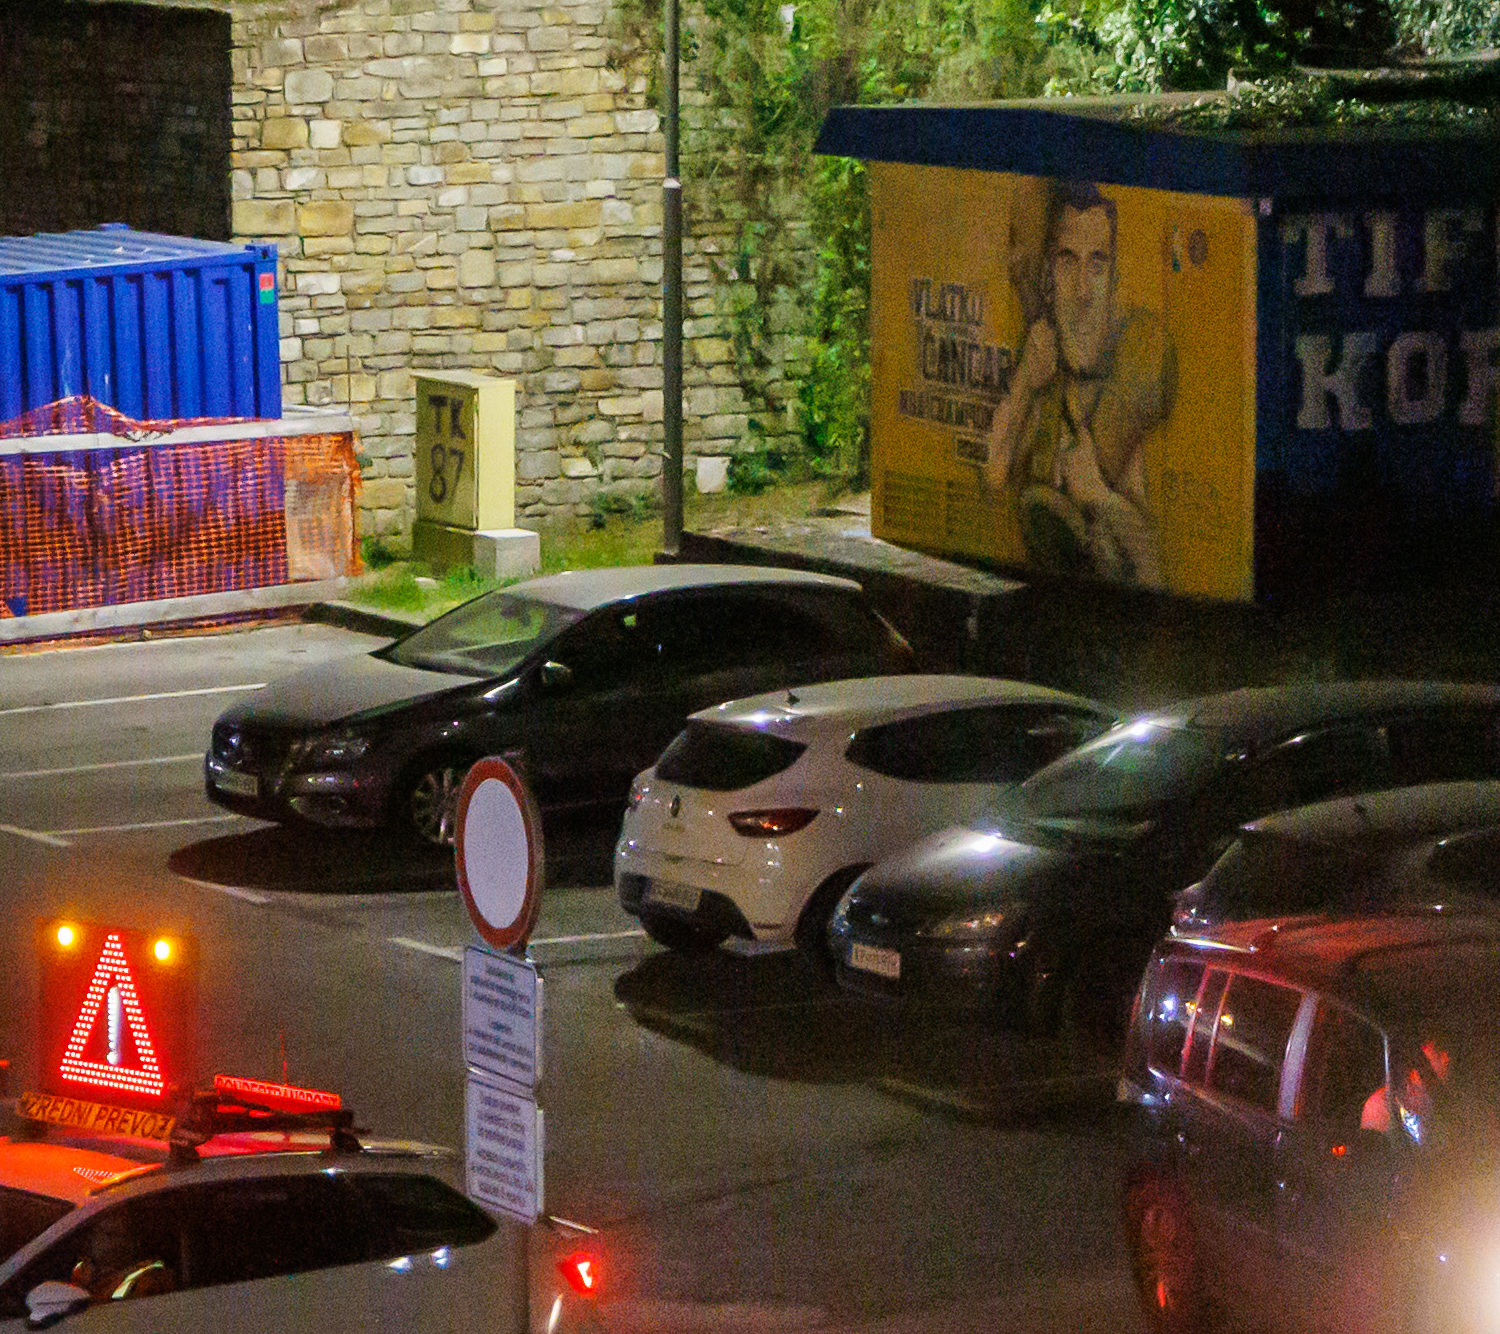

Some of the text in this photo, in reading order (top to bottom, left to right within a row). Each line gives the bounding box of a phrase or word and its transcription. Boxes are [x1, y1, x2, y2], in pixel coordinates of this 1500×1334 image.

[428, 394, 467, 441] TK
[429, 443, 466, 505] 87
[93, 1105, 171, 1140] PREVOZ
